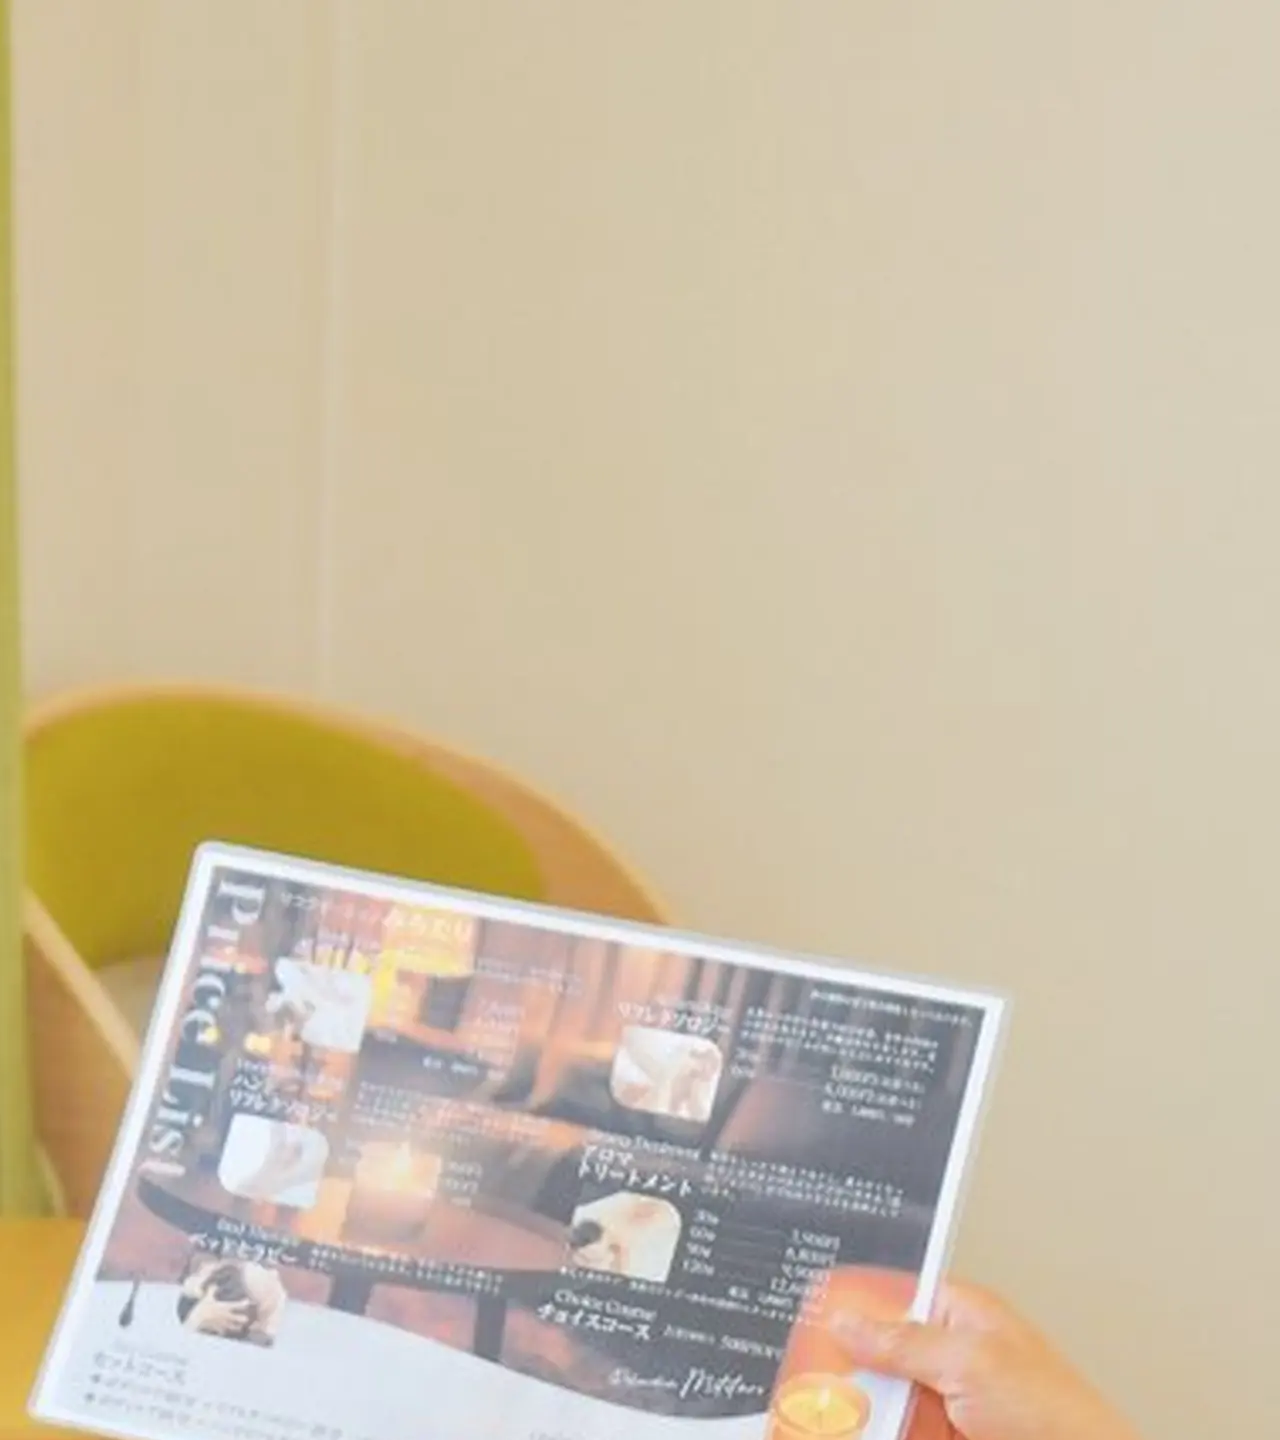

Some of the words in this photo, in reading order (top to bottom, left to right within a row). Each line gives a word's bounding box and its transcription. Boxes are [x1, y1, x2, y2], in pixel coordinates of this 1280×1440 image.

[182, 878, 266, 1046] Price
[137, 1062, 216, 1180] List
[575, 1157, 694, 1200] トリートメント
[533, 1299, 654, 1342] チョイスコース
